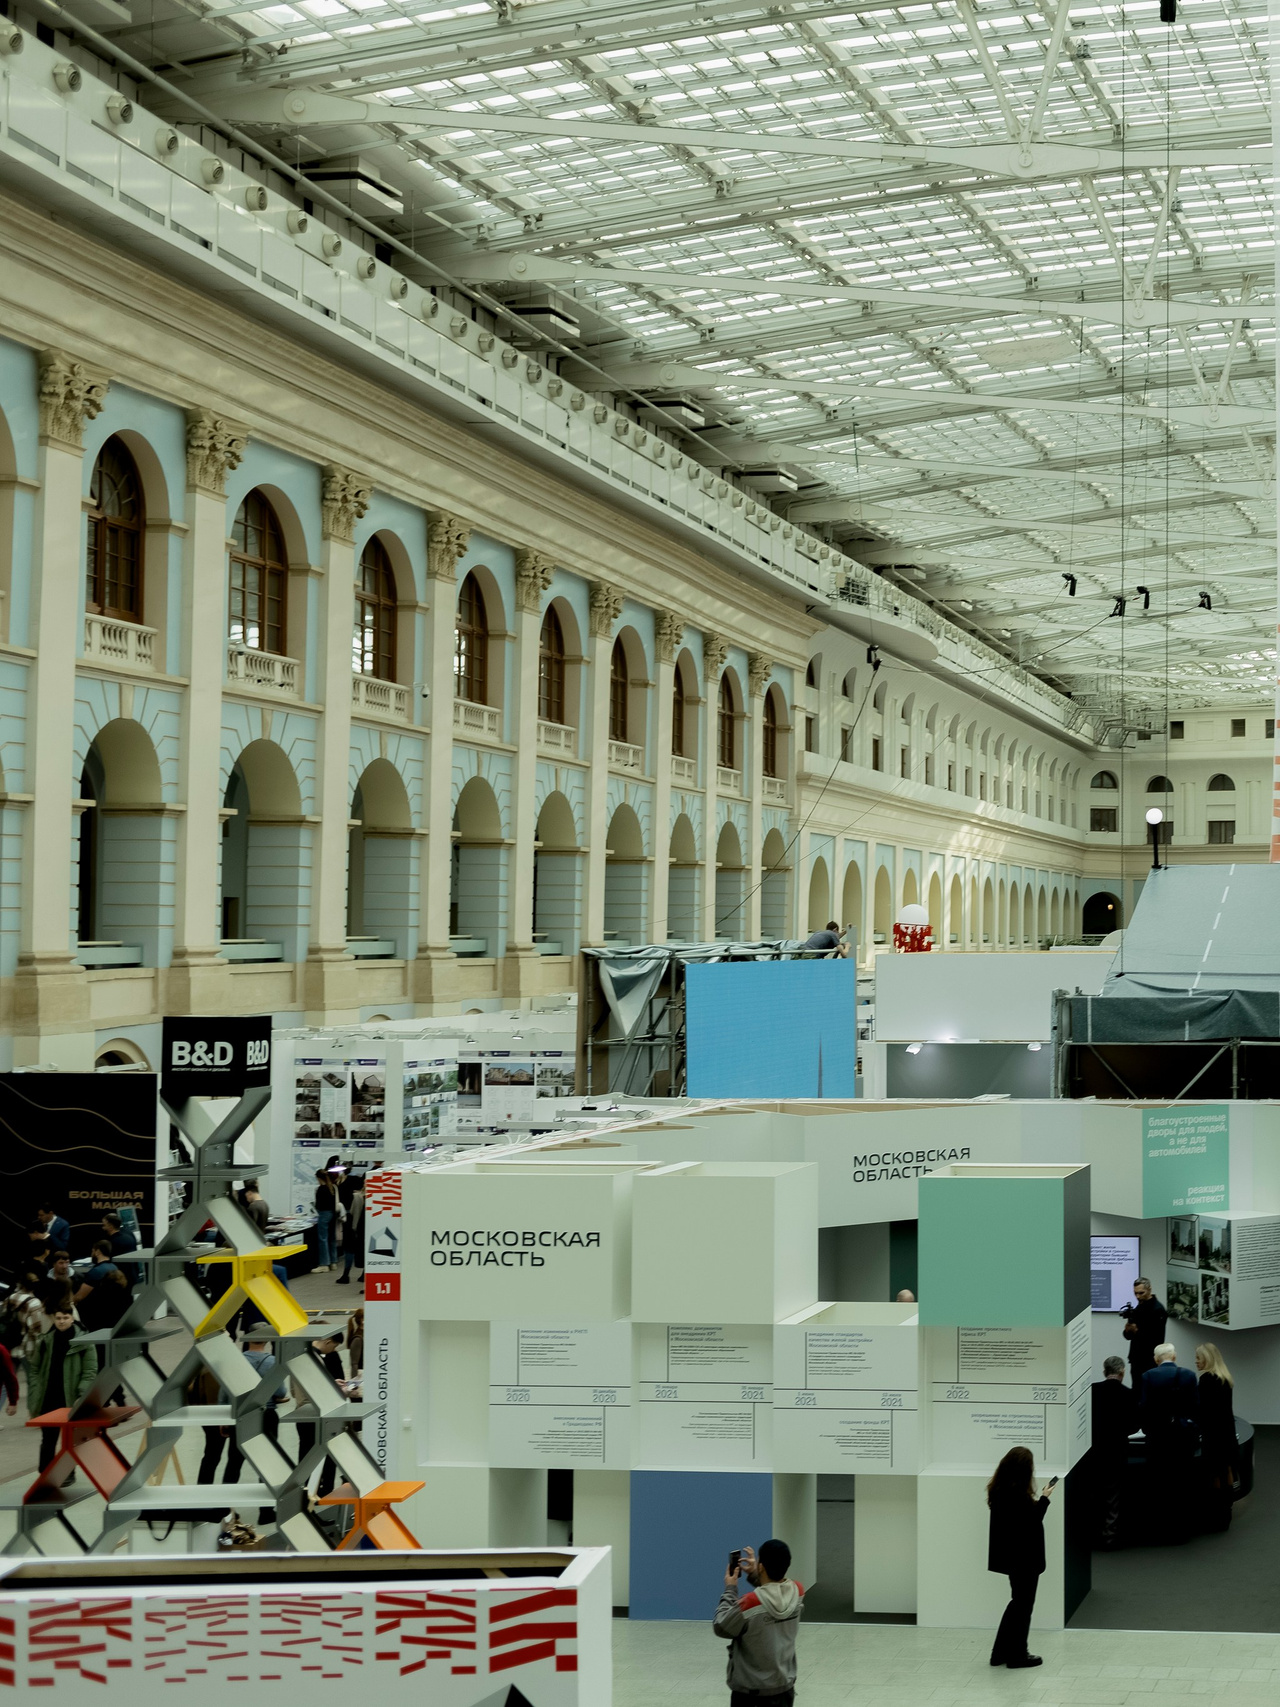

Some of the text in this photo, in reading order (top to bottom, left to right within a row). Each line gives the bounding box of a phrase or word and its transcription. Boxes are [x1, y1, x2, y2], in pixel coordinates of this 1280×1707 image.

[172, 1041, 234, 1066] B&D
[246, 1040, 269, 1065] B&D
[1148, 1114, 1226, 1127] благоустроенные
[1147, 1123, 1227, 1138] дворы для людей,
[1189, 1136, 1207, 1145] для
[1148, 1144, 1207, 1157] автомобилей
[853, 1147, 970, 1168] МОСКОВСКАЯ
[853, 1165, 933, 1183] ОБЛАСТЬ
[68, 1190, 144, 1199] БОЛЬШАЯ
[1187, 1184, 1225, 1196] реакция
[1173, 1194, 1225, 1206] на контекст
[431, 1230, 600, 1247] МОСКОВСКАЯ
[430, 1250, 545, 1266] ОБЛАСТЬ
[375, 1282, 391, 1294] 1.1
[506, 1393, 530, 1402] 2020
[592, 1394, 616, 1403] 2020
[655, 1389, 678, 1399] 2021
[741, 1390, 764, 1400] 2021
[946, 1390, 969, 1399] 2022
[1033, 1392, 1058, 1401] 2022
[377, 1337, 389, 1468] КОВСКА ОБЛАСТЬ
[795, 1396, 817, 1406] 2021
[880, 1397, 903, 1407] 2021
